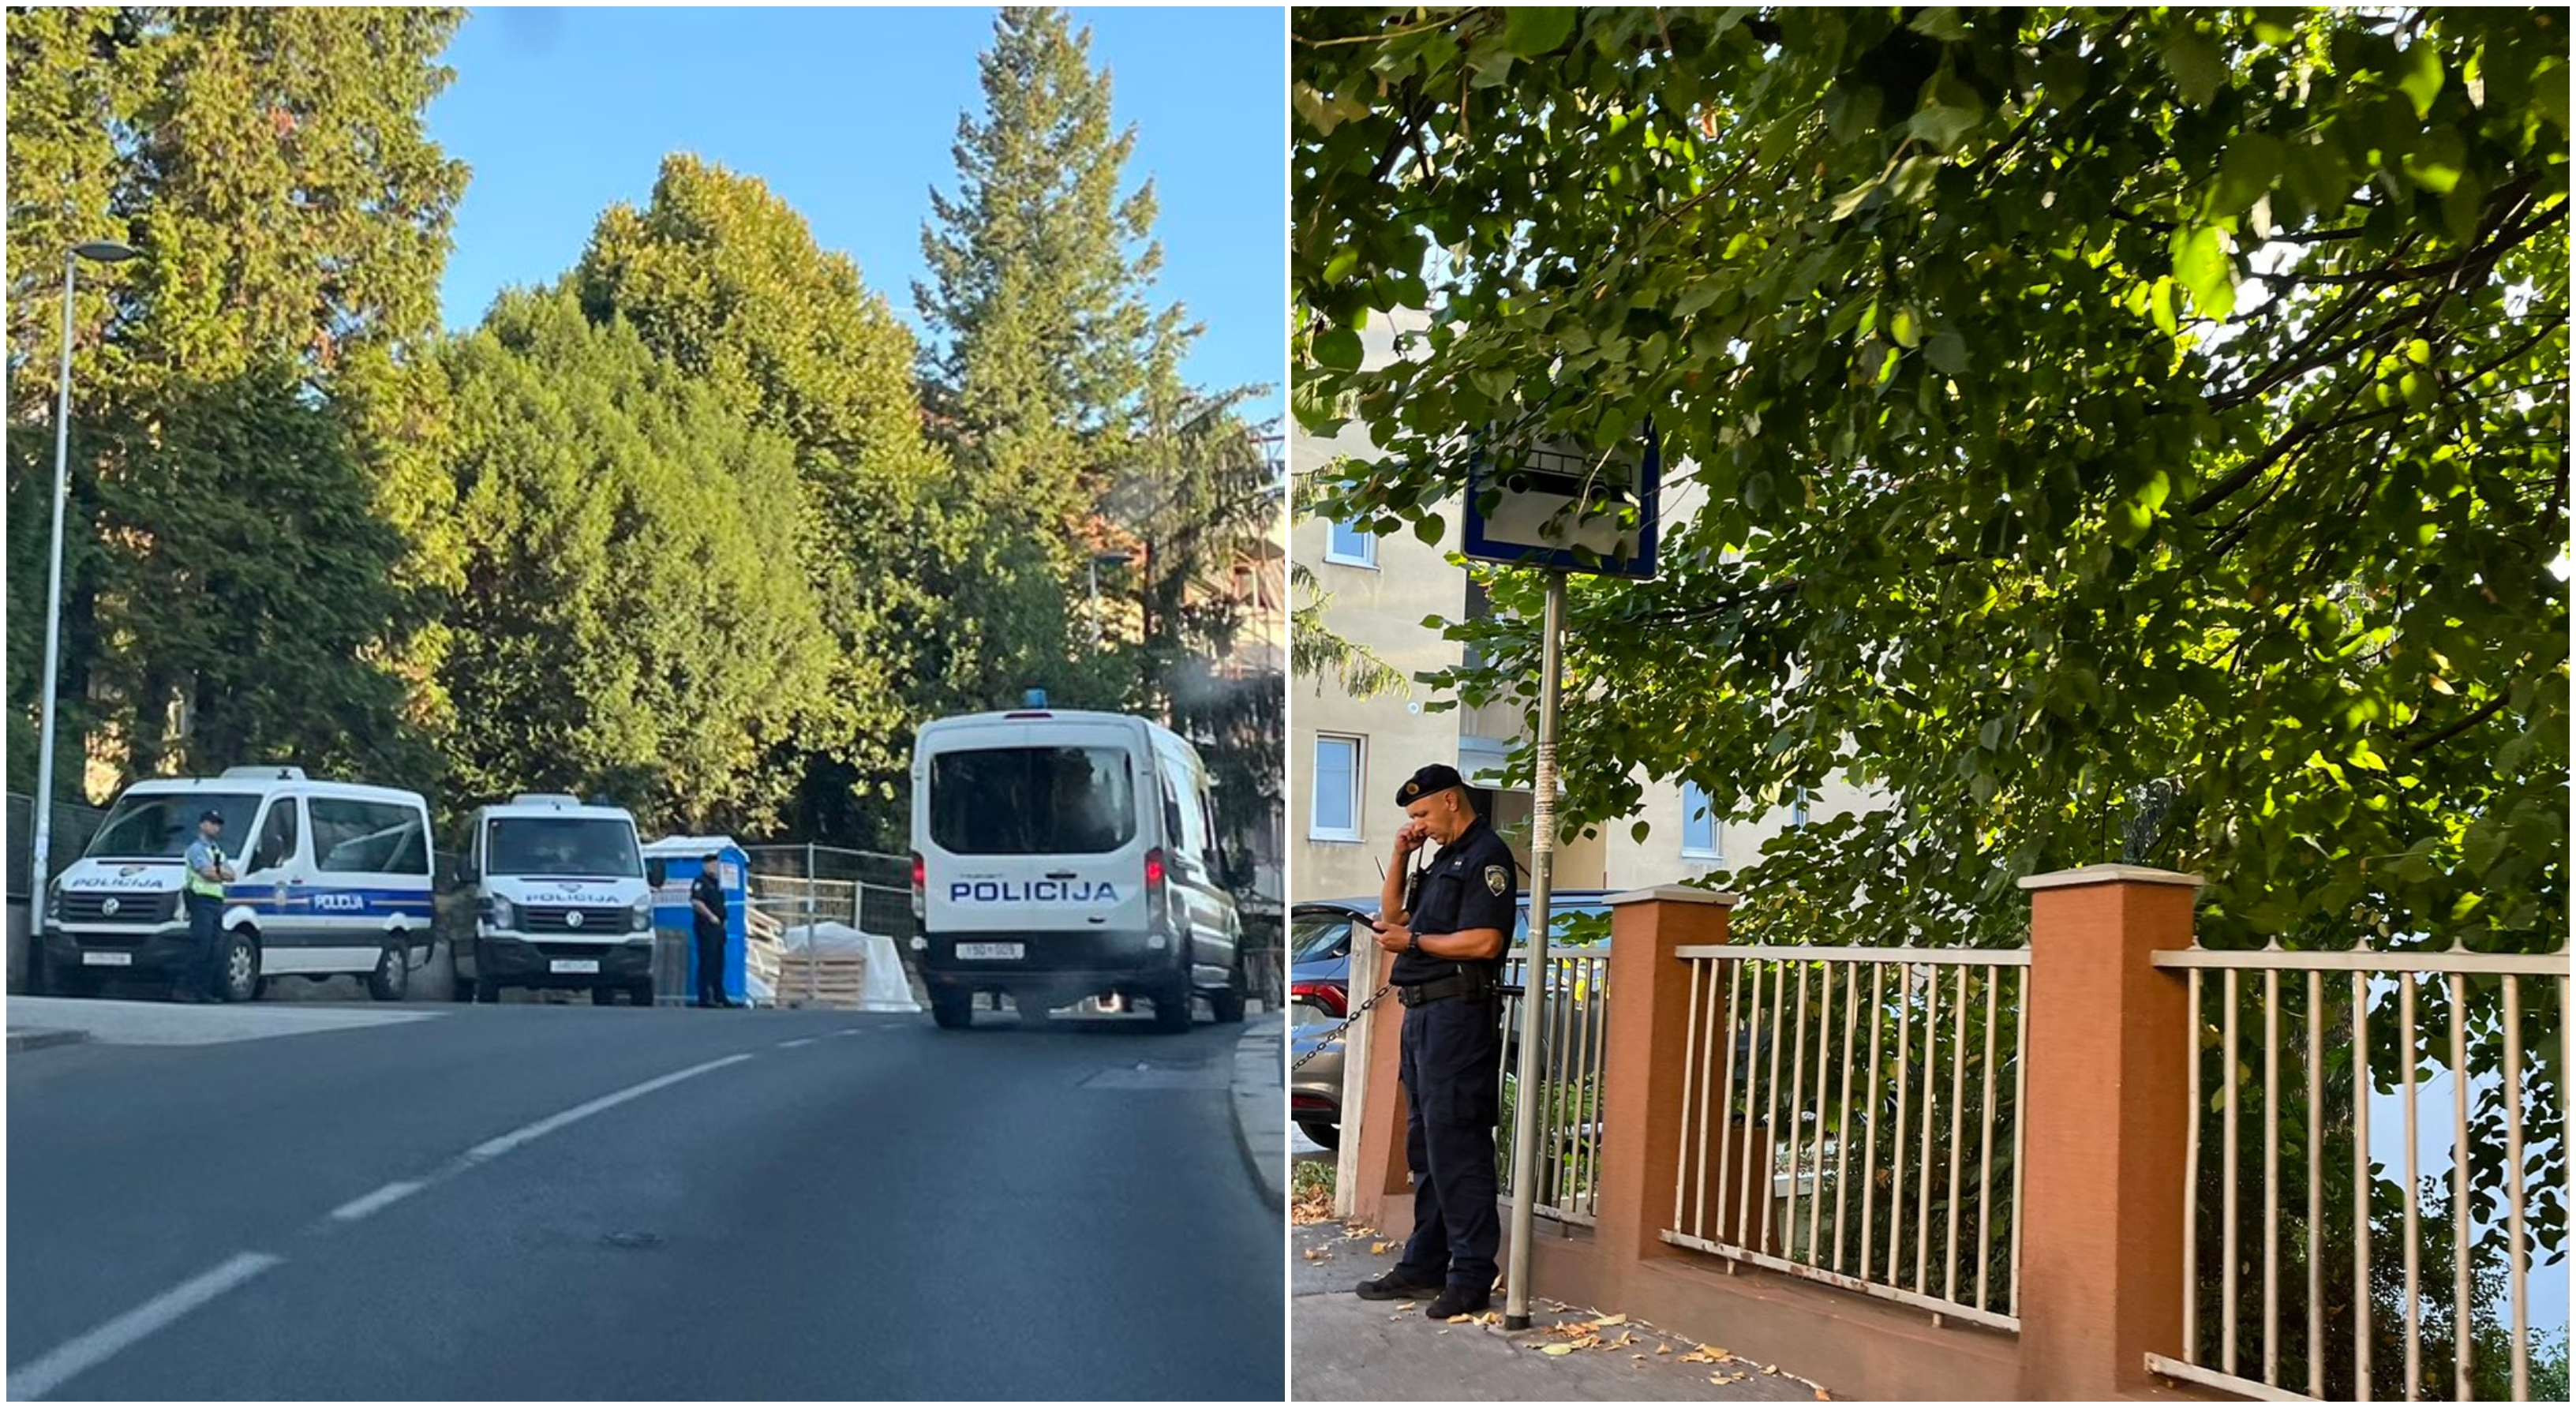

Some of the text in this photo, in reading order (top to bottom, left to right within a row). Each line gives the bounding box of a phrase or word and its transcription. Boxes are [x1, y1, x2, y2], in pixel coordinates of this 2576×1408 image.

[72, 878, 163, 889] POLICIJA
[525, 893, 620, 904] POLICIJA
[950, 882, 1118, 901] POLICIJA
[314, 893, 364, 910] POLICIJA
